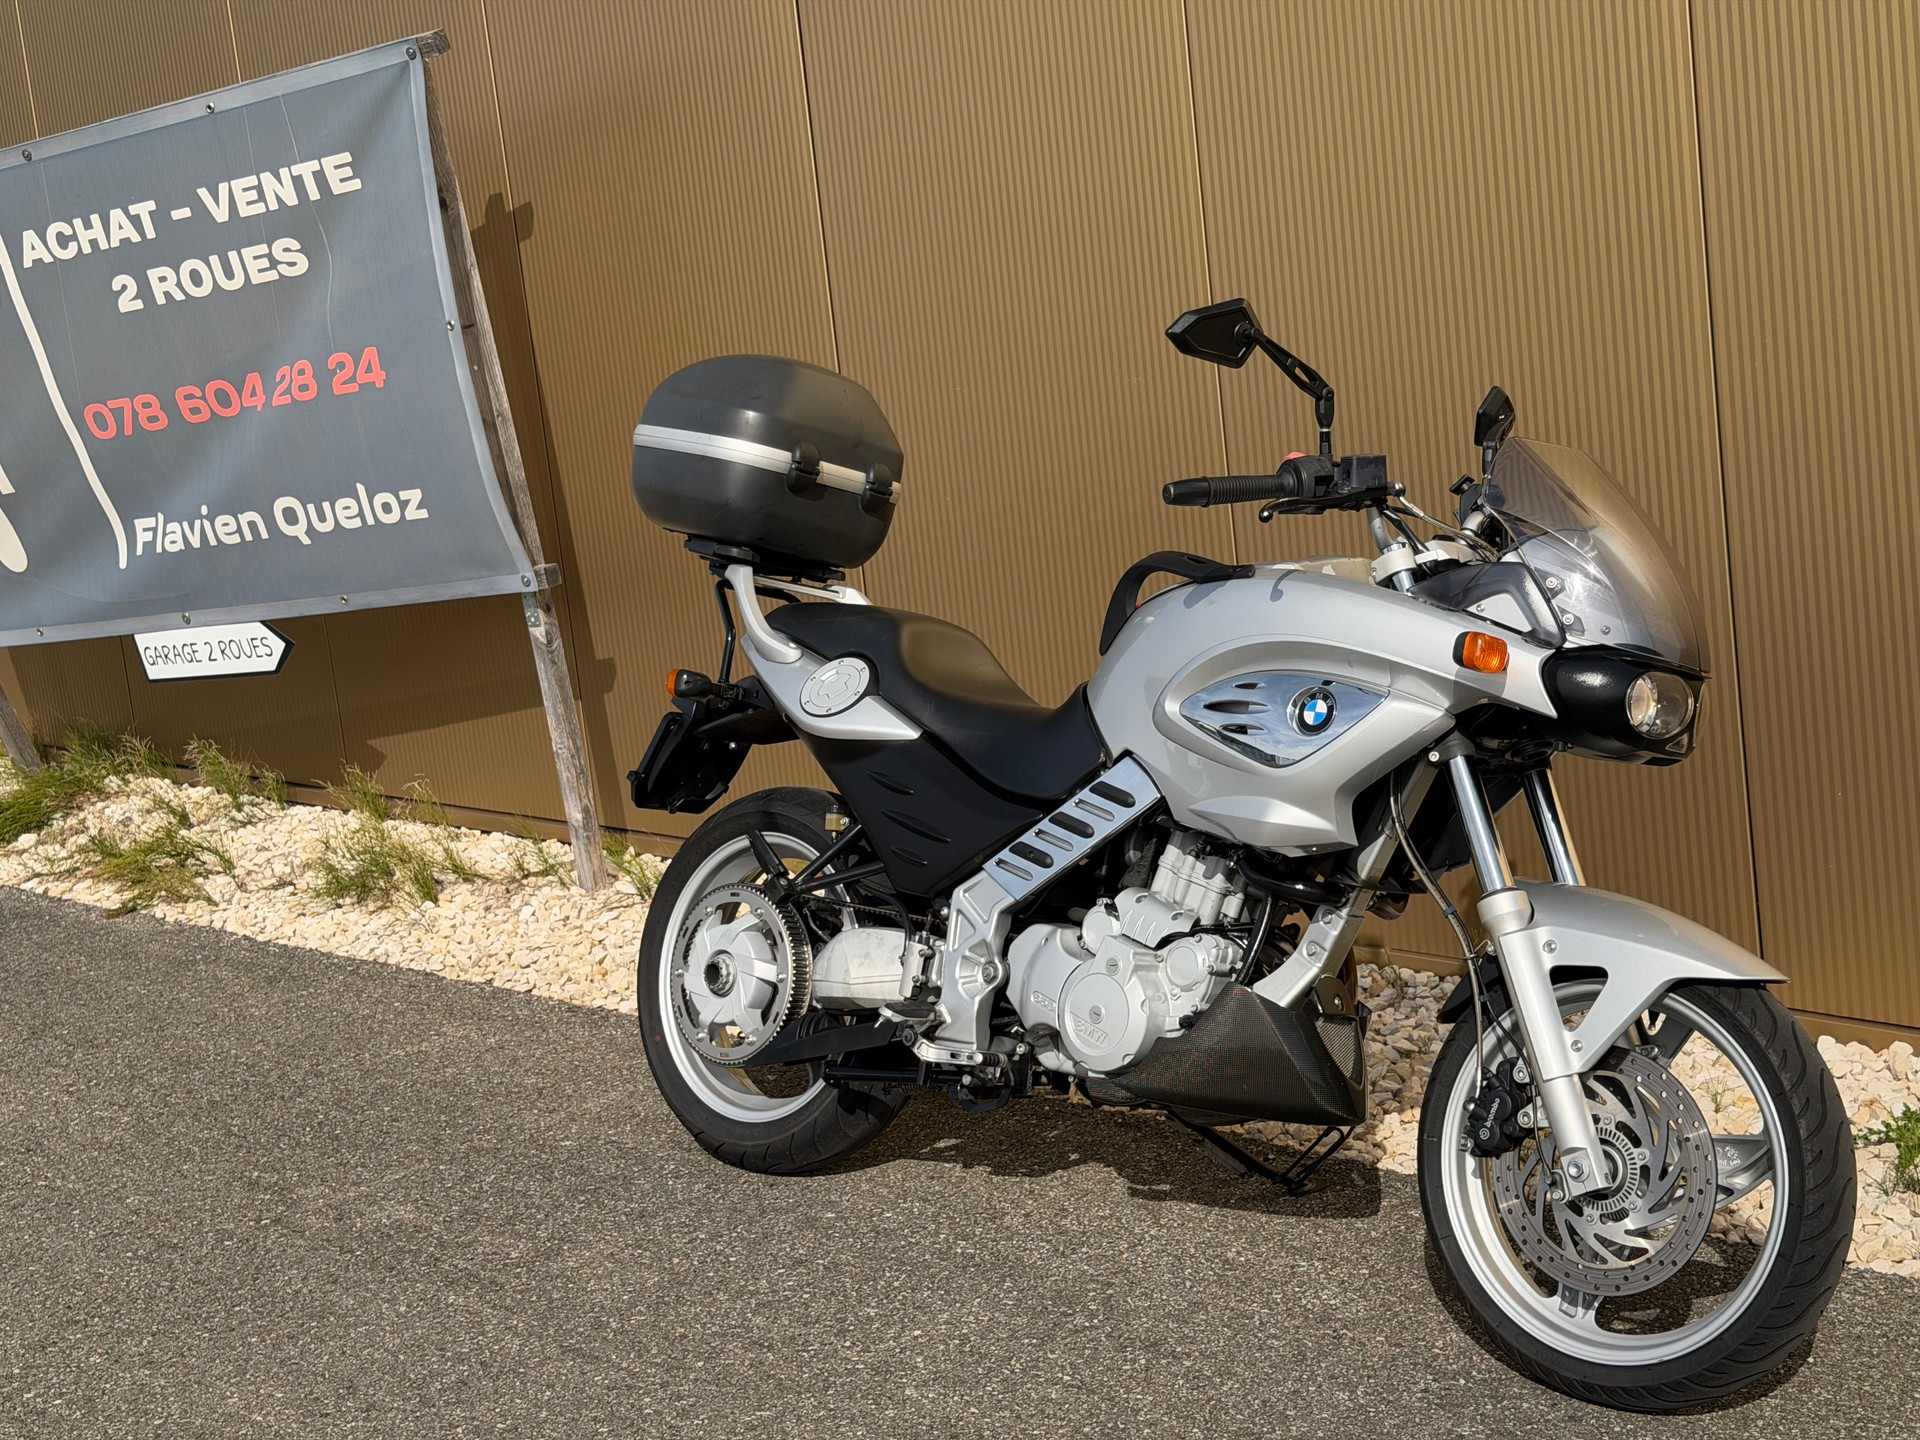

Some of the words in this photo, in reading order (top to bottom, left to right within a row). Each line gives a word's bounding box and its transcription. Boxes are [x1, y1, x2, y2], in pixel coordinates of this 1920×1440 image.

[22, 199, 157, 269] ACHAT
[196, 151, 362, 223] VENTE
[111, 274, 145, 314] 2
[146, 237, 310, 306] ROUES
[84, 394, 169, 440] 078
[174, 372, 266, 424] 604
[271, 360, 318, 407] 28
[327, 346, 387, 396] 24
[134, 504, 270, 556] Flavien
[273, 482, 430, 545] Queloz
[143, 642, 203, 667] GARAGE
[203, 641, 218, 662] 2
[217, 636, 274, 662] ROUES
[1303, 692, 1334, 707] BMW
[1076, 1019, 1108, 1046] BMW
[1483, 1097, 1501, 1128] brembo
